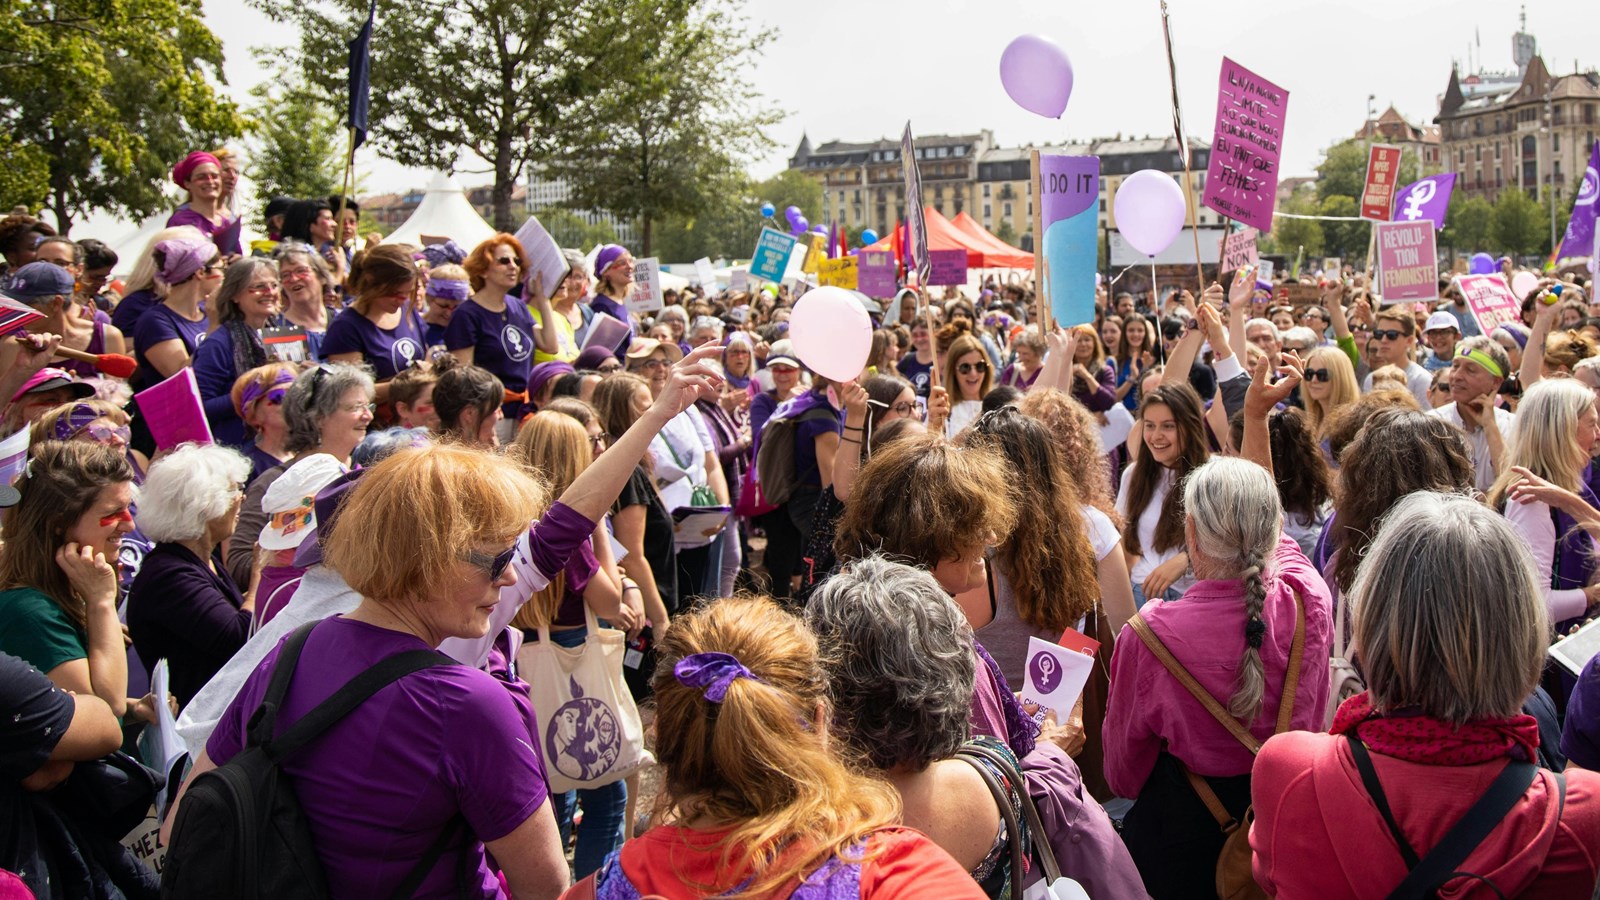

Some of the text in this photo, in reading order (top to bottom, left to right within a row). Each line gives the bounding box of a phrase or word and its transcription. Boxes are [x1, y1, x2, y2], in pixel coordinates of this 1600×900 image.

[1216, 138, 1275, 174] EN TANT QUE
[1050, 172, 1068, 194] DO
[1077, 173, 1093, 194] IT
[1221, 166, 1258, 192] FEMMES
[1383, 226, 1426, 249] RÉVOLU-
[1227, 250, 1250, 270] NON
[1394, 247, 1420, 267] TION
[1384, 264, 1435, 289] FÉMINISTE
[1479, 305, 1515, 330] GRÈVE
[127, 828, 164, 858] HEZ
